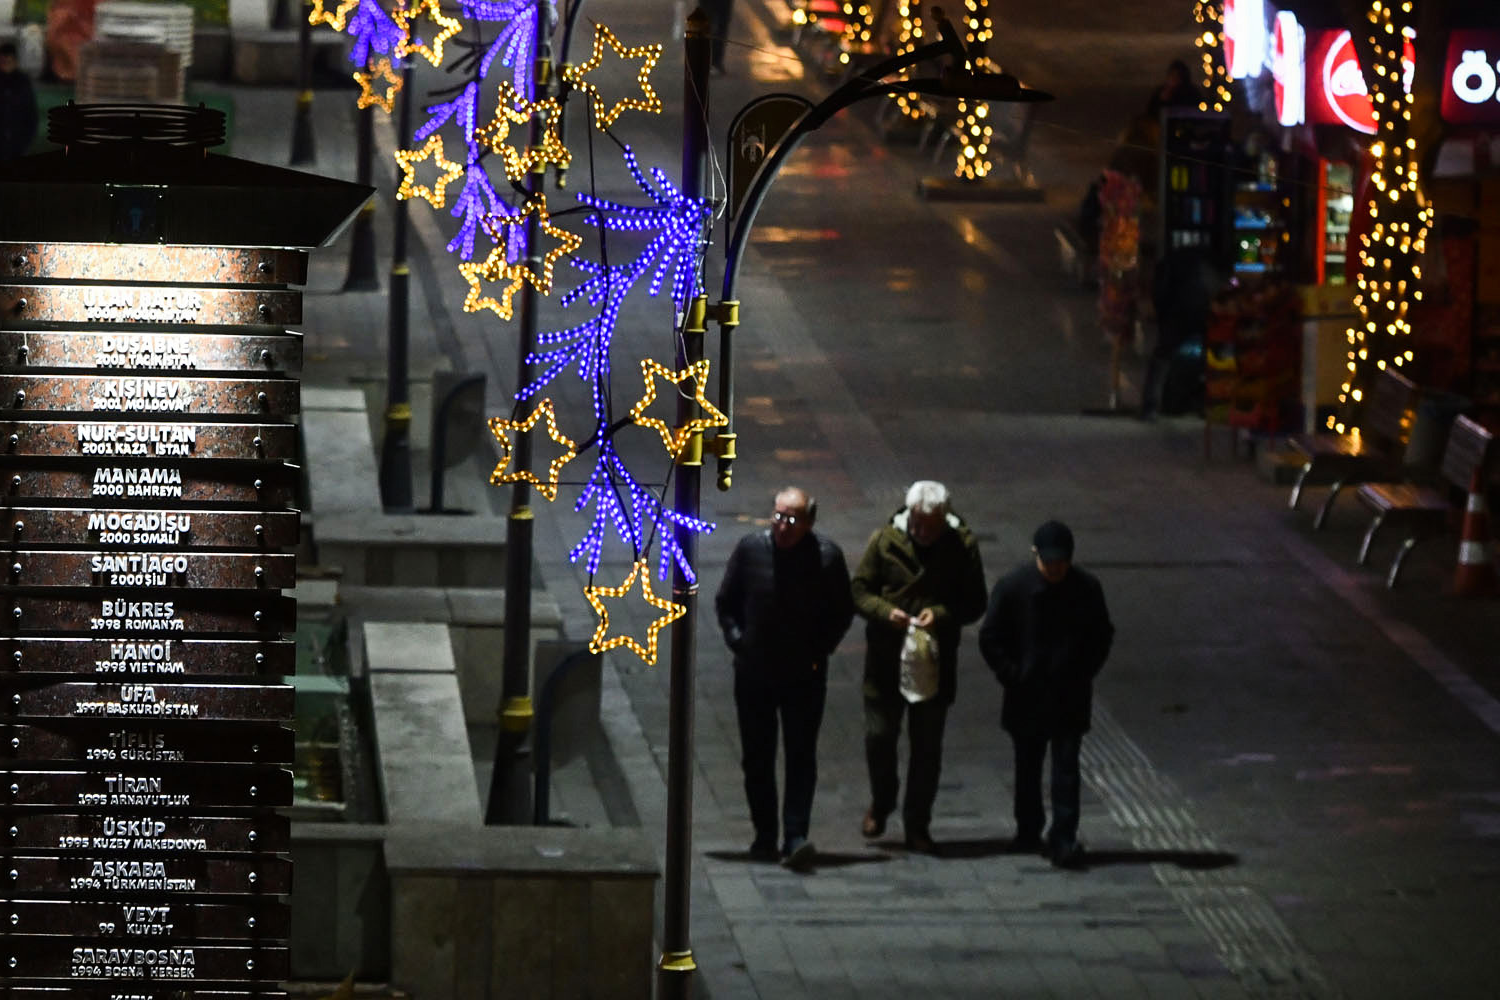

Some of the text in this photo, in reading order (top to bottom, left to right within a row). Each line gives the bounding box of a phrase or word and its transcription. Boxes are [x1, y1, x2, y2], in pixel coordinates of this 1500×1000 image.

[93, 398, 121, 410] 2001
[78, 425, 196, 442] NUR-SULTAN
[82, 442, 113, 454] 2001
[93, 468, 182, 484] MANAMA
[92, 484, 182, 497] 2000 BAHREYN
[100, 532, 130, 544] 2000
[111, 574, 144, 586] 2000
[102, 598, 174, 619] BÜKREŞ
[91, 618, 184, 631] 1998 ROMANYA
[95, 661, 127, 673] 1998
[121, 686, 156, 702] UFA
[86, 749, 117, 760] 1996
[104, 774, 162, 793] TİRAN
[78, 793, 190, 806] 1995 ARNAVUTLUK
[103, 817, 166, 837] ÜSKÜP
[59, 836, 207, 850] 1995 KUZEY MAKEDONYA
[70, 877, 101, 889] 1994
[71, 948, 196, 965] SARAYBOSNA
[71, 965, 195, 978] 1994 BOSNA HERSEK
